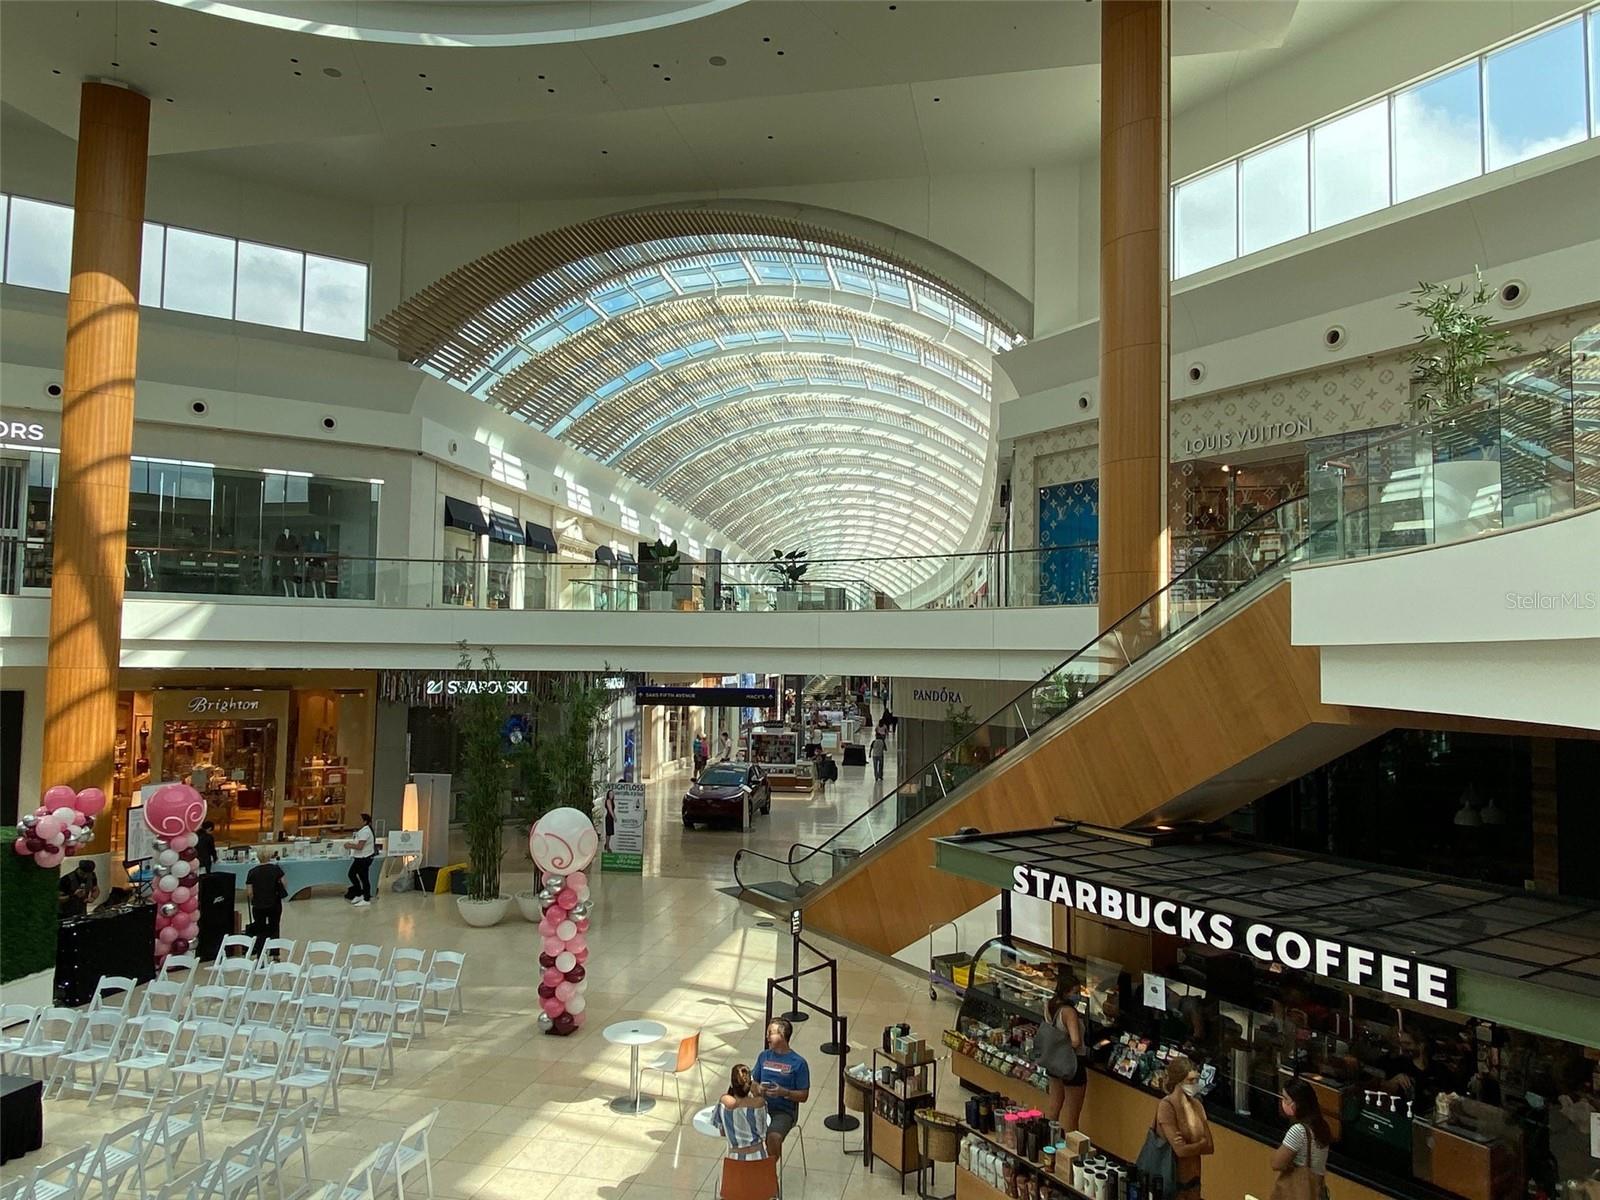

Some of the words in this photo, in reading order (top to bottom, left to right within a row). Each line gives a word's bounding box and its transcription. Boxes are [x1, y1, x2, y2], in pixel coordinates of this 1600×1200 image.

[1184, 432, 1232, 455] LOUIS
[1236, 418, 1312, 445] VUITTON
[185, 696, 259, 713] Brighton
[913, 688, 962, 703] PANDORA
[1012, 864, 1234, 950] STARBUCKS
[1246, 923, 1448, 1009] COFFEE
